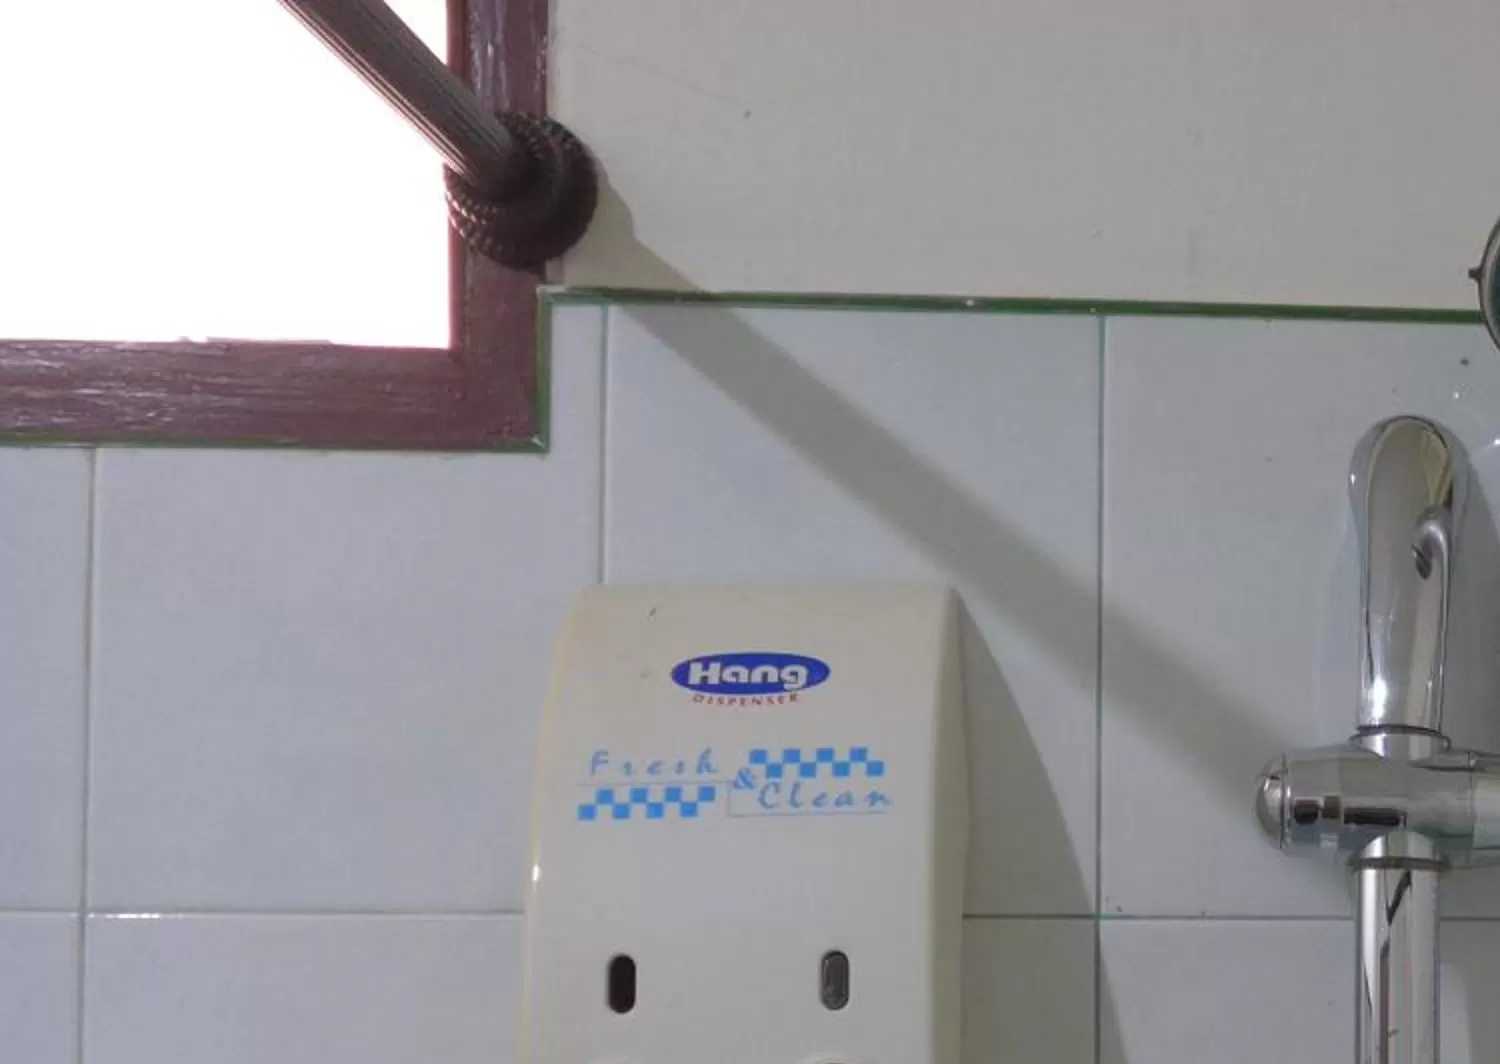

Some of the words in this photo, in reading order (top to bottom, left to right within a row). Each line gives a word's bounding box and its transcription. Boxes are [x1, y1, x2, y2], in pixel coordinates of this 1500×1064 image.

[688, 661, 808, 691] Hang
[692, 693, 799, 706] DISPENSER
[591, 747, 718, 777] Fresh
[758, 781, 891, 809] Clean
